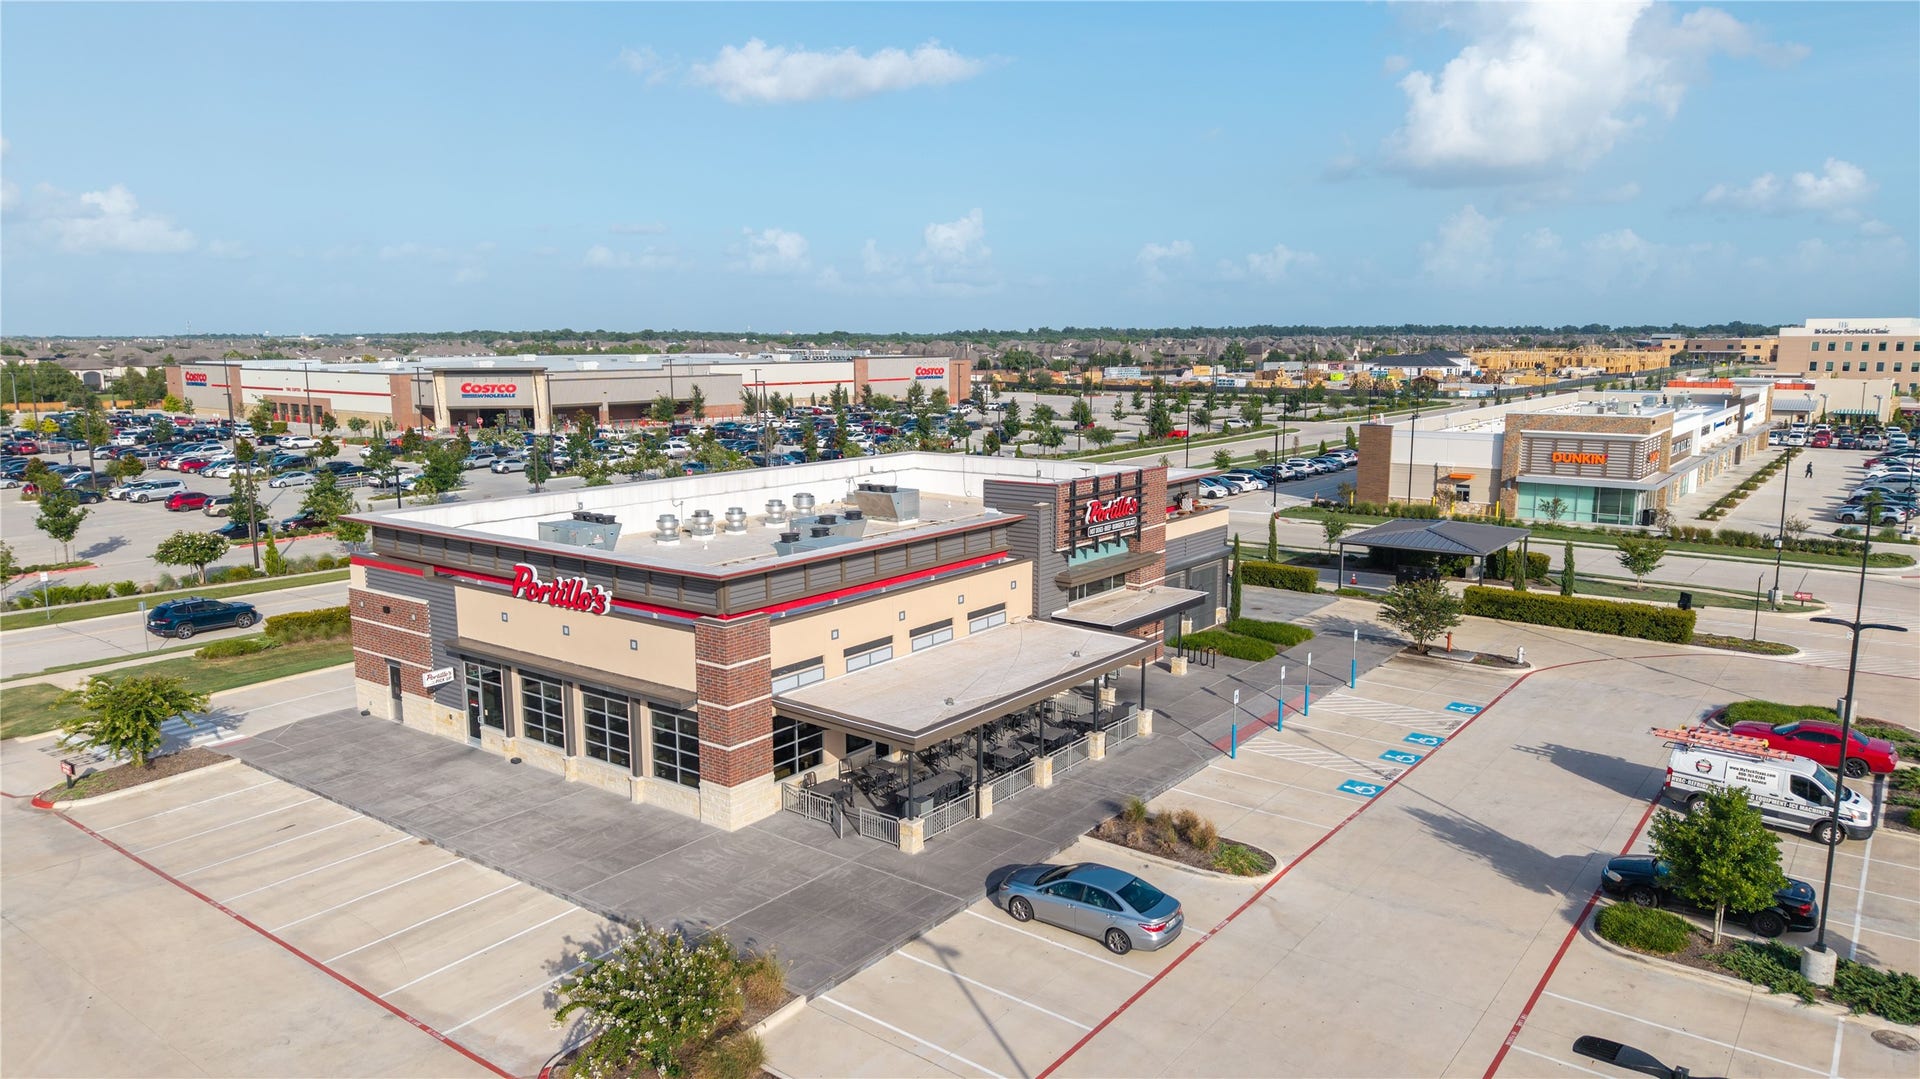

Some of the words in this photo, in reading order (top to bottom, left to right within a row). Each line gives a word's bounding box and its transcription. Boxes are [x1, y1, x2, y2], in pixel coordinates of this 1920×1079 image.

[915, 366, 945, 375] COSTCO
[460, 382, 517, 393] COSTCO
[1085, 496, 1138, 524] Portillo's
[512, 563, 613, 615] Portillo's
